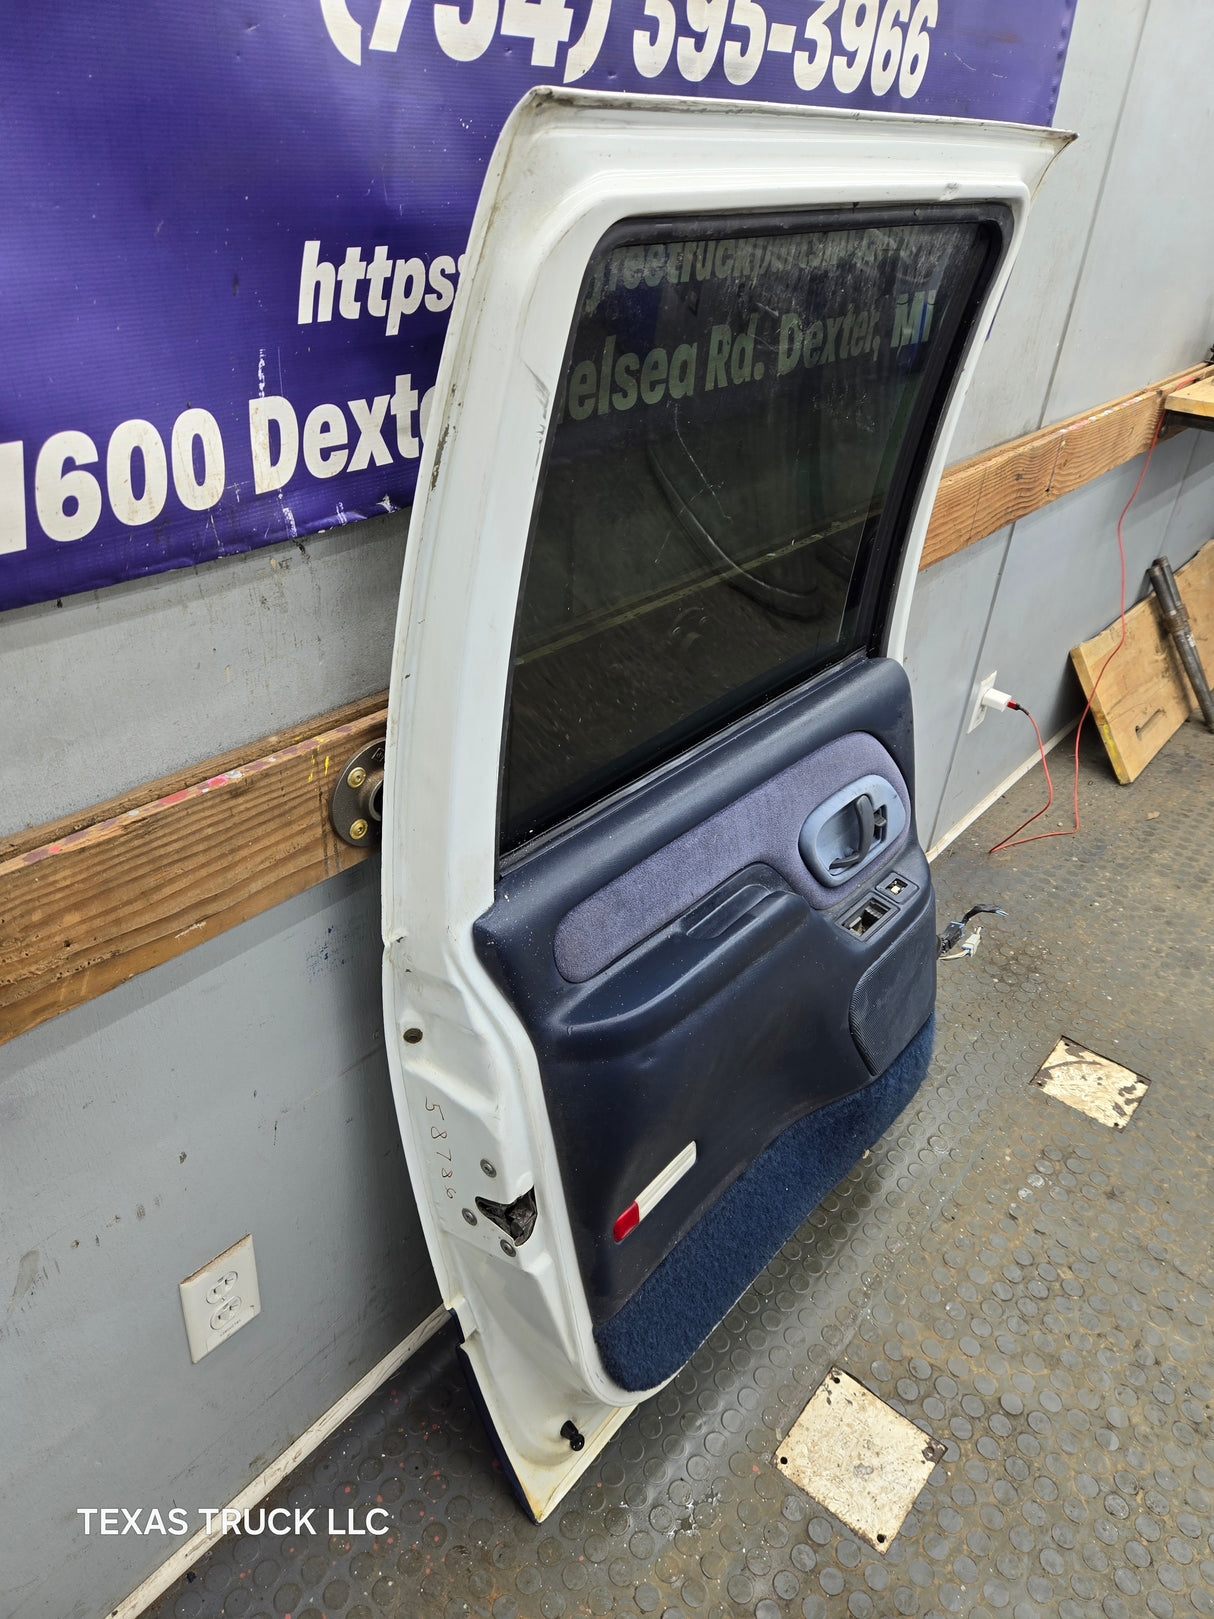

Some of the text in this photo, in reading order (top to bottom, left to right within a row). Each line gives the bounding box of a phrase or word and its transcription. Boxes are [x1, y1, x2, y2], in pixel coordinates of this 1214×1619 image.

[633, 0, 938, 98] 395-3966
[298, 240, 466, 336] https
[557, 335, 698, 424] elsea
[705, 313, 765, 391] Rd.
[777, 303, 881, 376] Dexter,
[890, 290, 937, 347] MI
